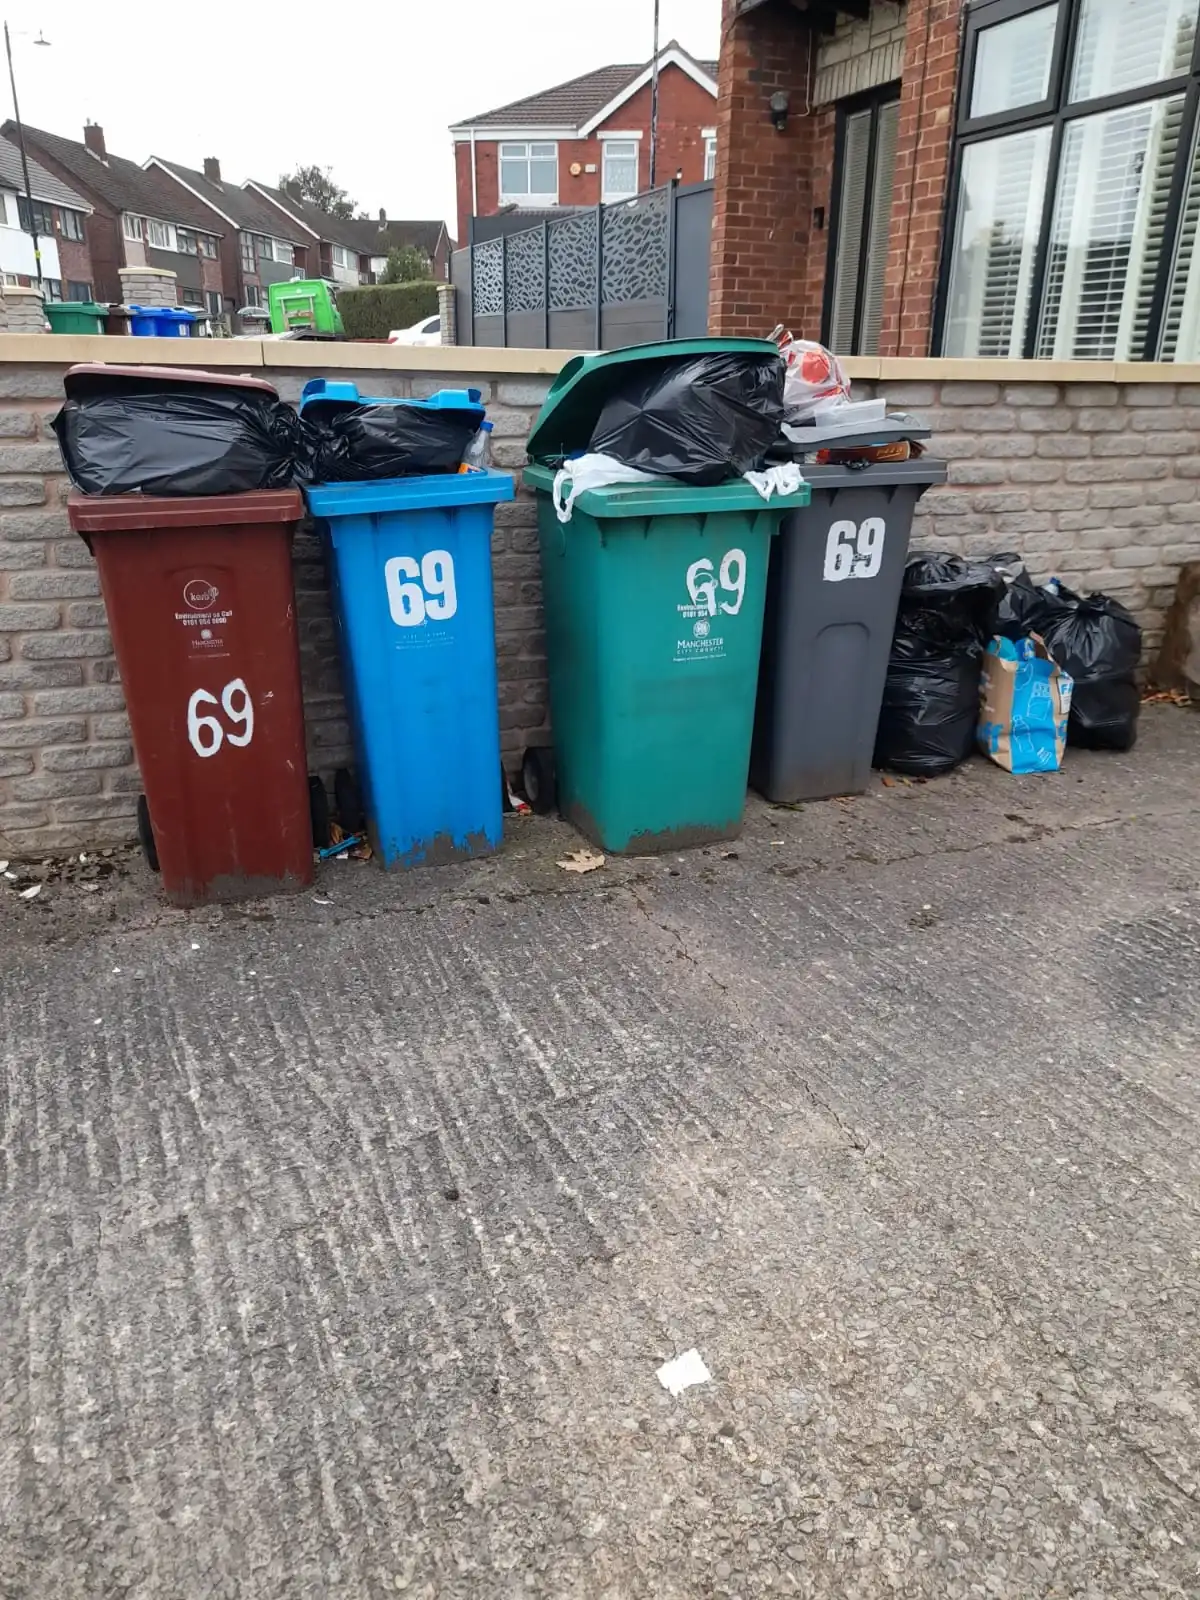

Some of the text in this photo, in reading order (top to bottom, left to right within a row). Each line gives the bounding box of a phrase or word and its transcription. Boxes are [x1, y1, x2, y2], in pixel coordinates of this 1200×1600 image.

[686, 548, 747, 616] 69
[823, 516, 886, 582] 69
[385, 549, 458, 627] 69
[677, 638, 724, 650] MANCHESTER
[187, 678, 254, 758] 69
